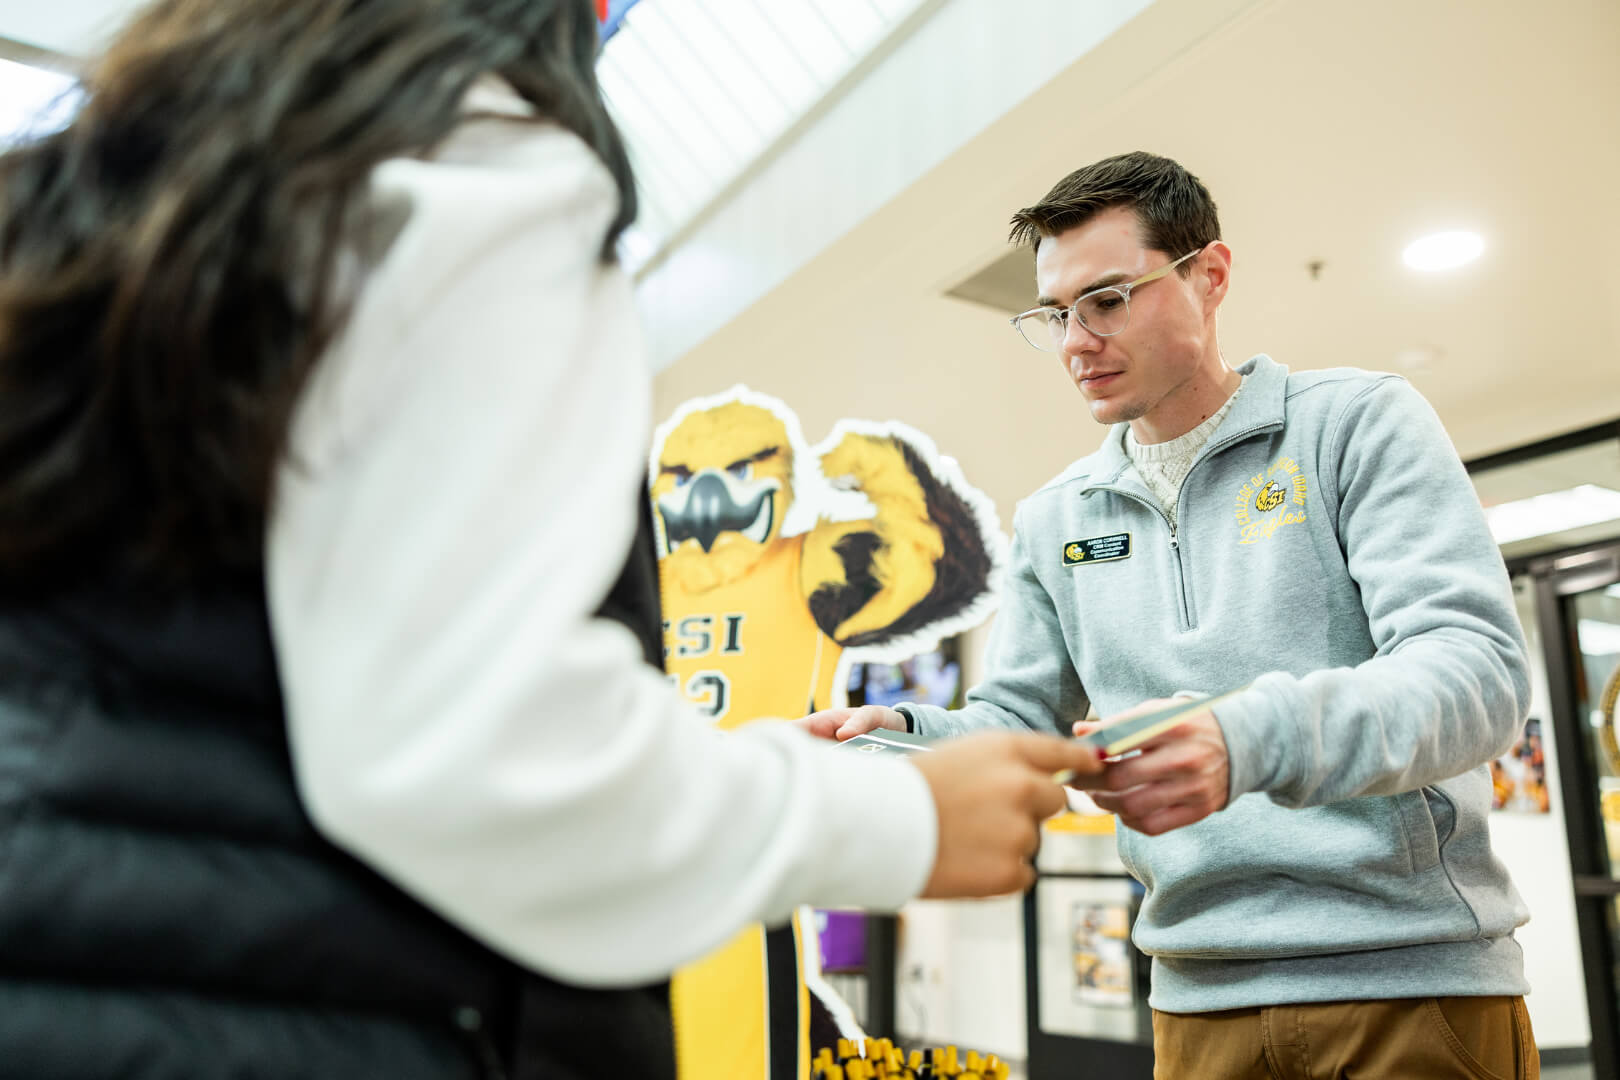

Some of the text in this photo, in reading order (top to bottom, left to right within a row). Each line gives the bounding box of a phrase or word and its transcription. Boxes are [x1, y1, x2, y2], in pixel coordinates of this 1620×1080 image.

[1235, 483, 1254, 526] COLLEGE
[1250, 473, 1264, 487] OF
[1291, 474, 1307, 506] IDAHO
[1264, 487, 1287, 512] CSI
[1238, 505, 1307, 545] Eagles
[662, 615, 743, 656] SI
